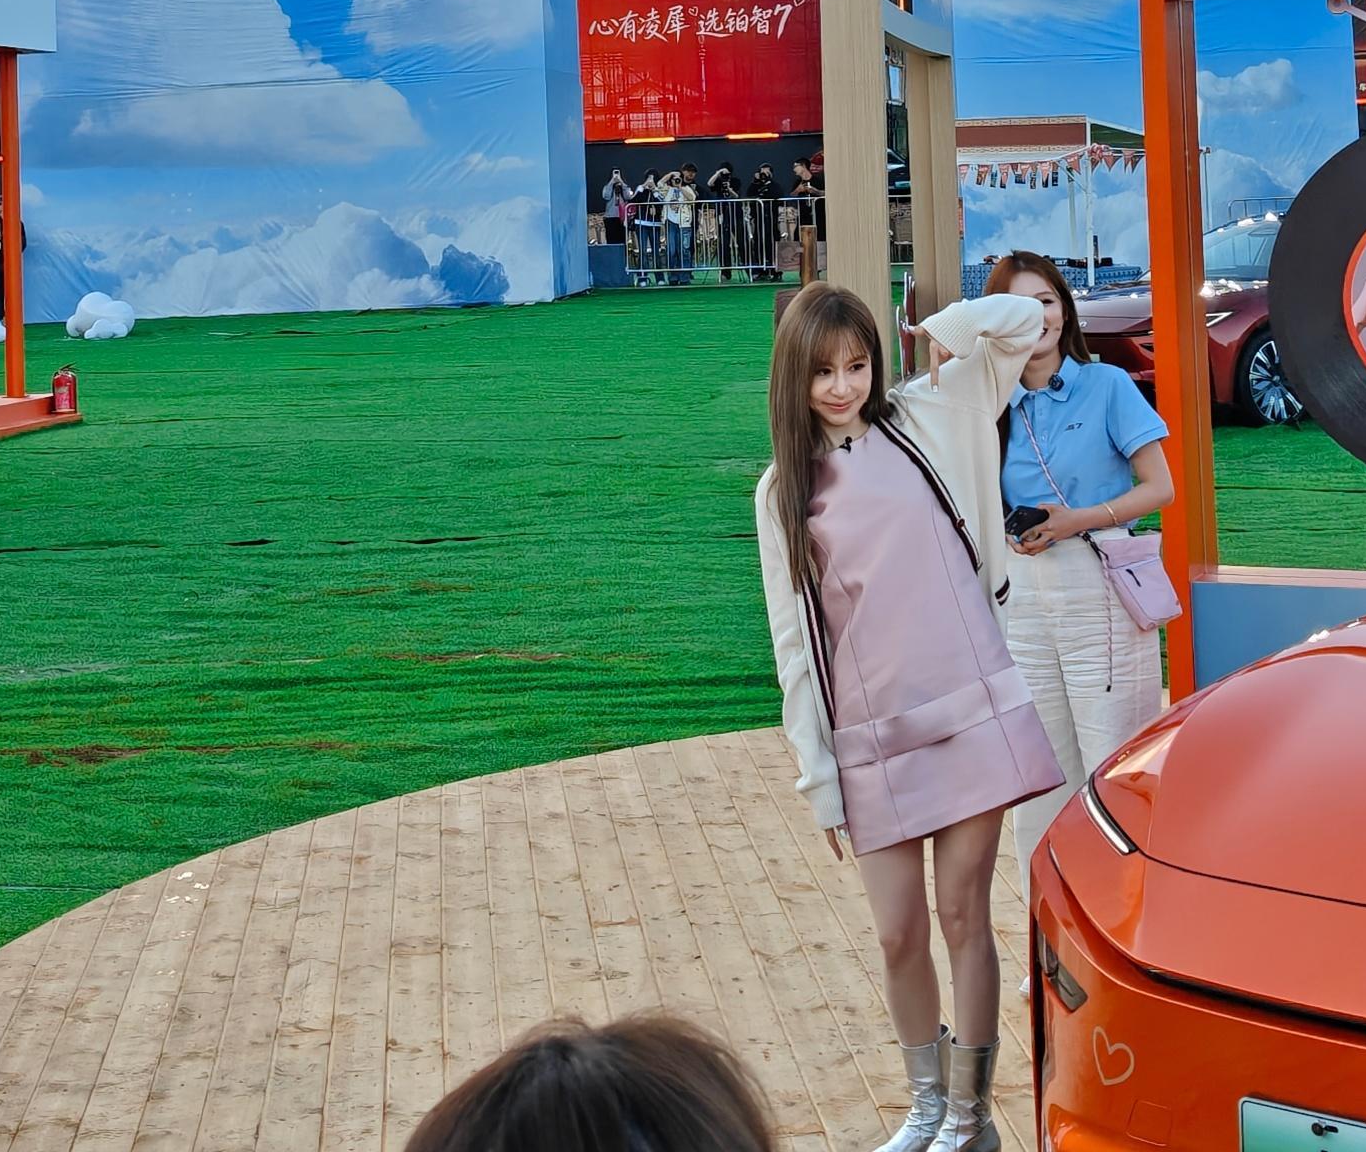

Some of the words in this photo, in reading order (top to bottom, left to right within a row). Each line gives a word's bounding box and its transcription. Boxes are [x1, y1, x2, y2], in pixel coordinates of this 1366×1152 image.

[588, 4, 690, 45] 心有凌犀
[695, 3, 794, 40] 选铂智7
